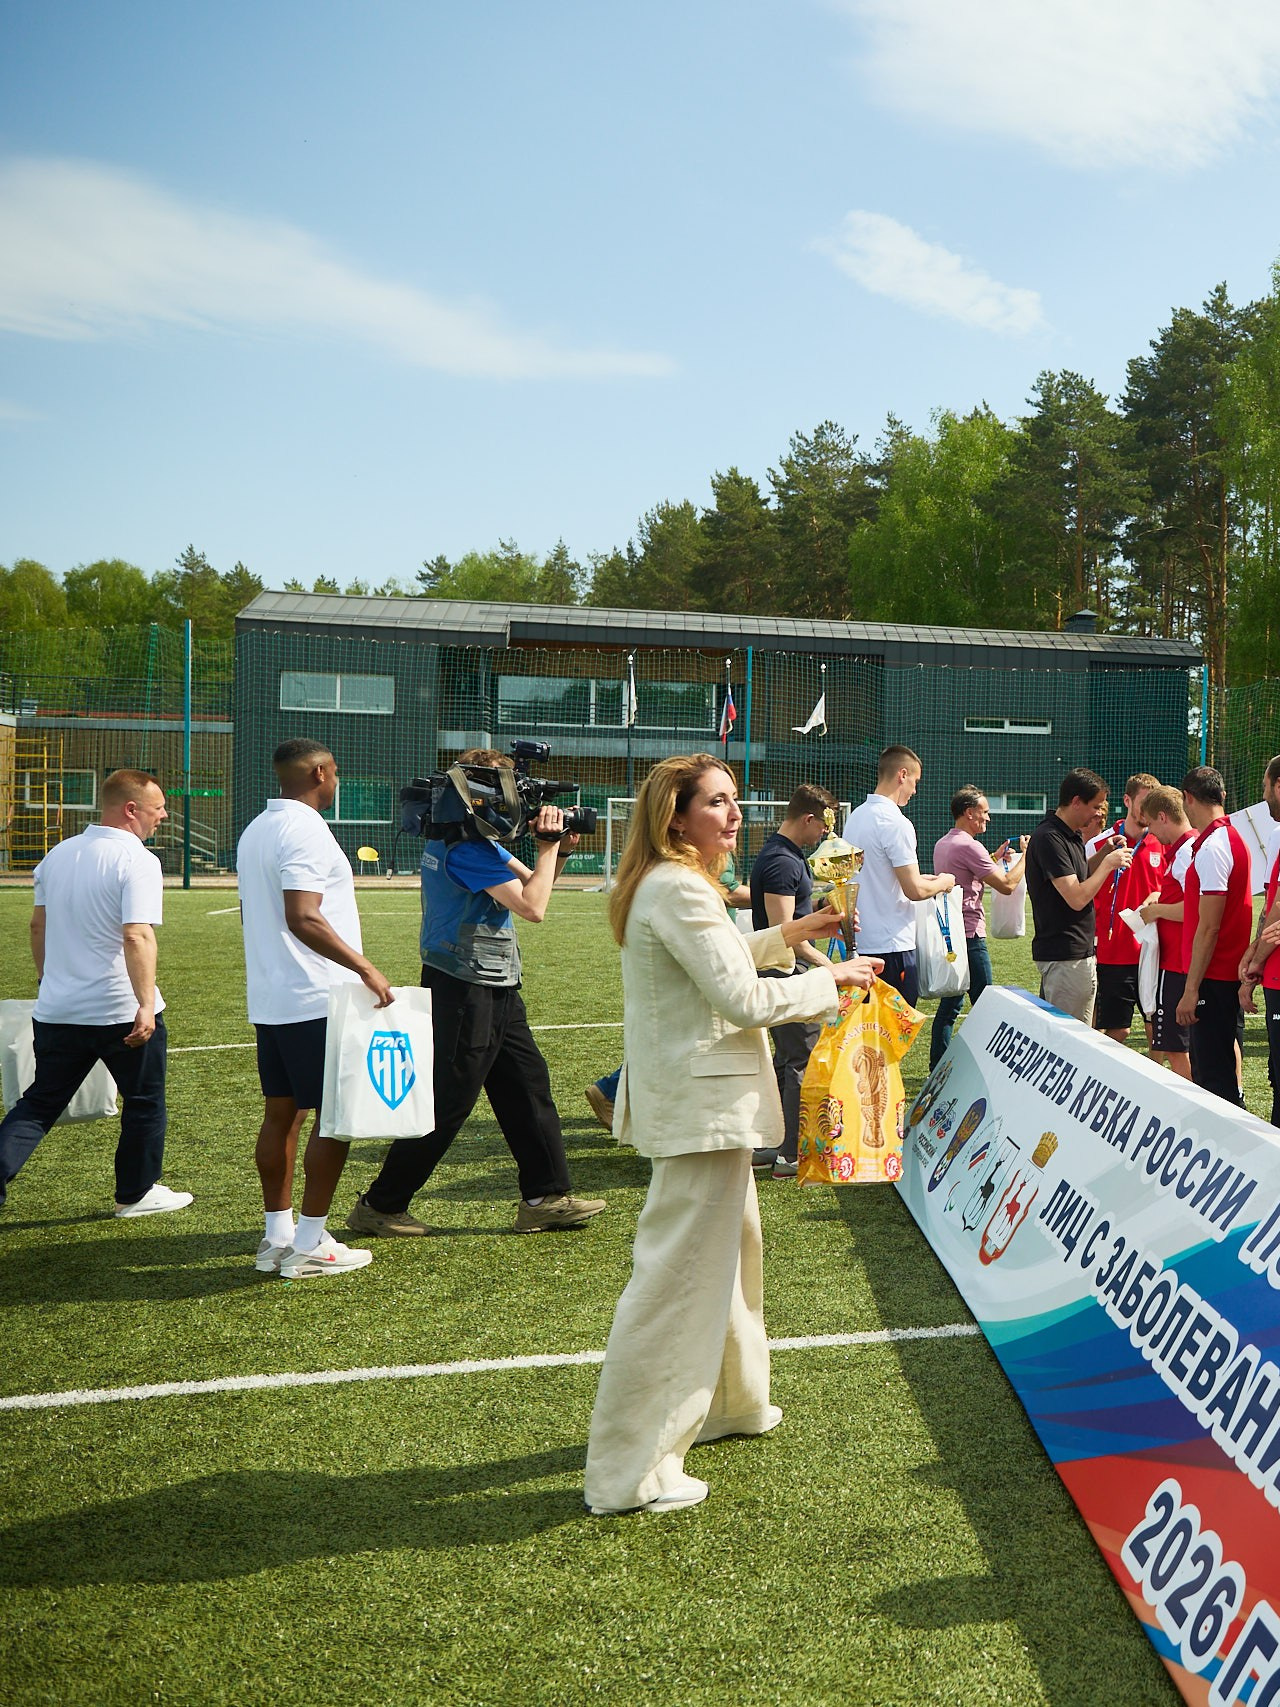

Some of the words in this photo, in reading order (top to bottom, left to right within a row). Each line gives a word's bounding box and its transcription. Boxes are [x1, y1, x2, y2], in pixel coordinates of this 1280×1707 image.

[986, 1021, 1078, 1106] ПОБЕДИТЕЛЬ
[1068, 1075, 1141, 1154] КУБКА
[1130, 1115, 1259, 1232] РОССИИ
[1038, 1179, 1095, 1263] ЛИЦ
[1080, 1220, 1111, 1269] С
[1128, 1491, 1237, 1658] 2026
